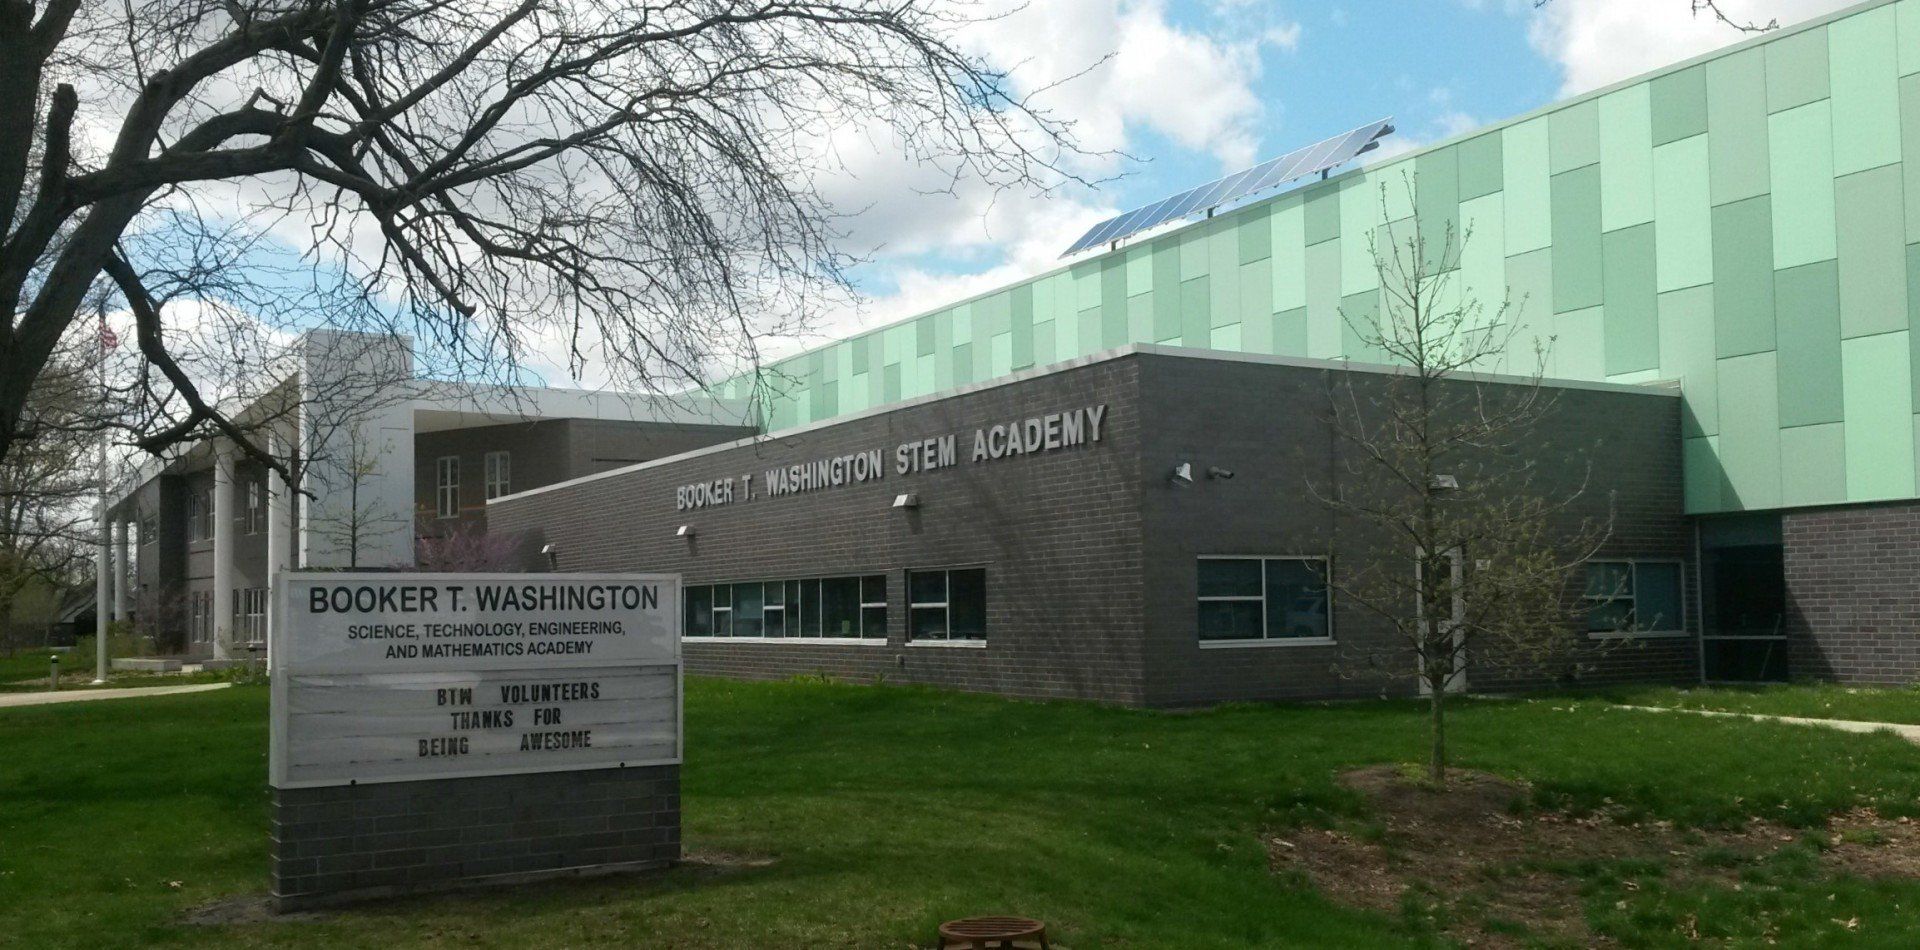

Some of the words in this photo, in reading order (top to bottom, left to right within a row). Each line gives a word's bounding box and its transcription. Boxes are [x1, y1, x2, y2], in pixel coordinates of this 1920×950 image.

[677, 477, 735, 511] BOOKER
[743, 473, 757, 500] T.
[765, 449, 884, 496] WASHINGTON
[895, 434, 957, 476] STEM
[971, 404, 1107, 463] ACADEMY
[309, 586, 438, 614] BOOKER
[447, 586, 467, 612] T.
[476, 585, 659, 613] WASHINGTON
[347, 624, 420, 640] SCIENCE,
[425, 623, 527, 638] TECHNOLOGY,
[529, 621, 626, 637] ENGINEERING,
[385, 644, 418, 659] AND
[421, 642, 525, 658] MATHEMATICS
[527, 640, 594, 655] ACADEMY
[436, 687, 473, 706] BTW
[500, 682, 600, 704] VOLUNTEERS
[450, 710, 513, 730] THANKS
[533, 707, 561, 726] FOR
[418, 736, 470, 757] BEING
[519, 730, 592, 752] AWESOME
